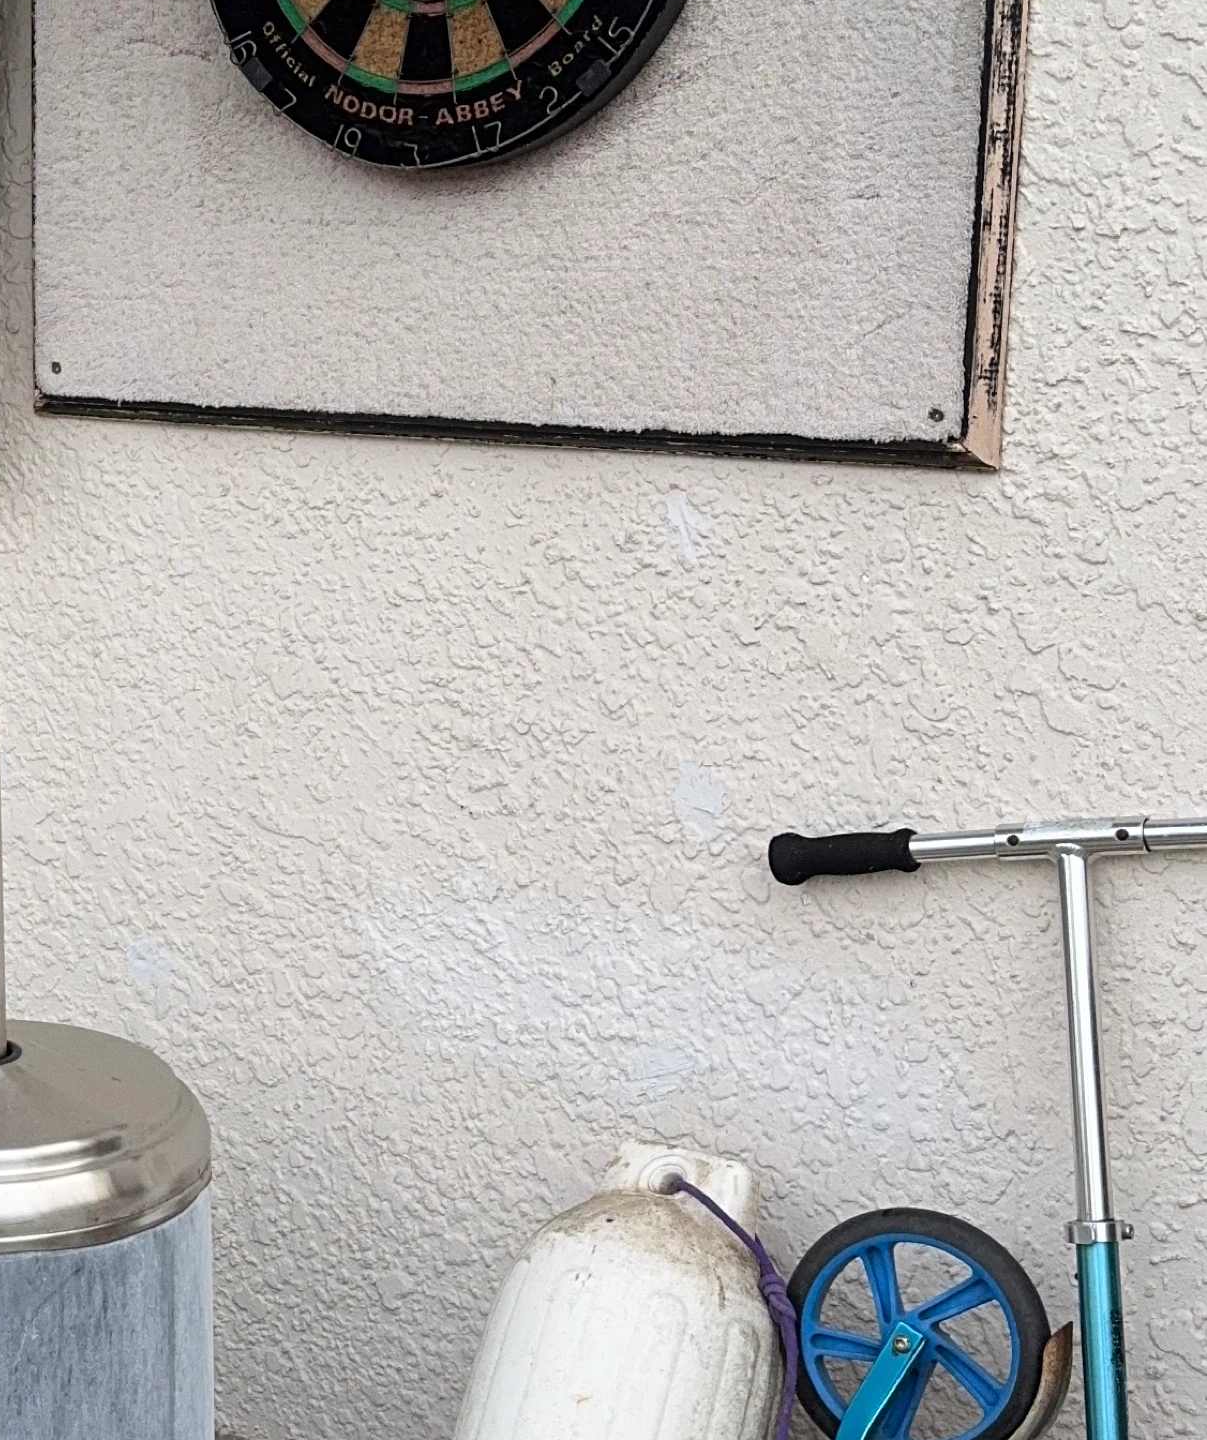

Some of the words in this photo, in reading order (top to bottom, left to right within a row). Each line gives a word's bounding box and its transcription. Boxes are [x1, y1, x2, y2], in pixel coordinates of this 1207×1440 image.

[596, 15, 636, 58] 15
[261, 20, 317, 88] Official
[323, 83, 415, 126] NODOR
[434, 78, 524, 126] ABBEY
[547, 13, 604, 78] Board
[538, 85, 563, 115] 2
[323, 123, 362, 161] 19
[471, 120, 502, 158] 17
